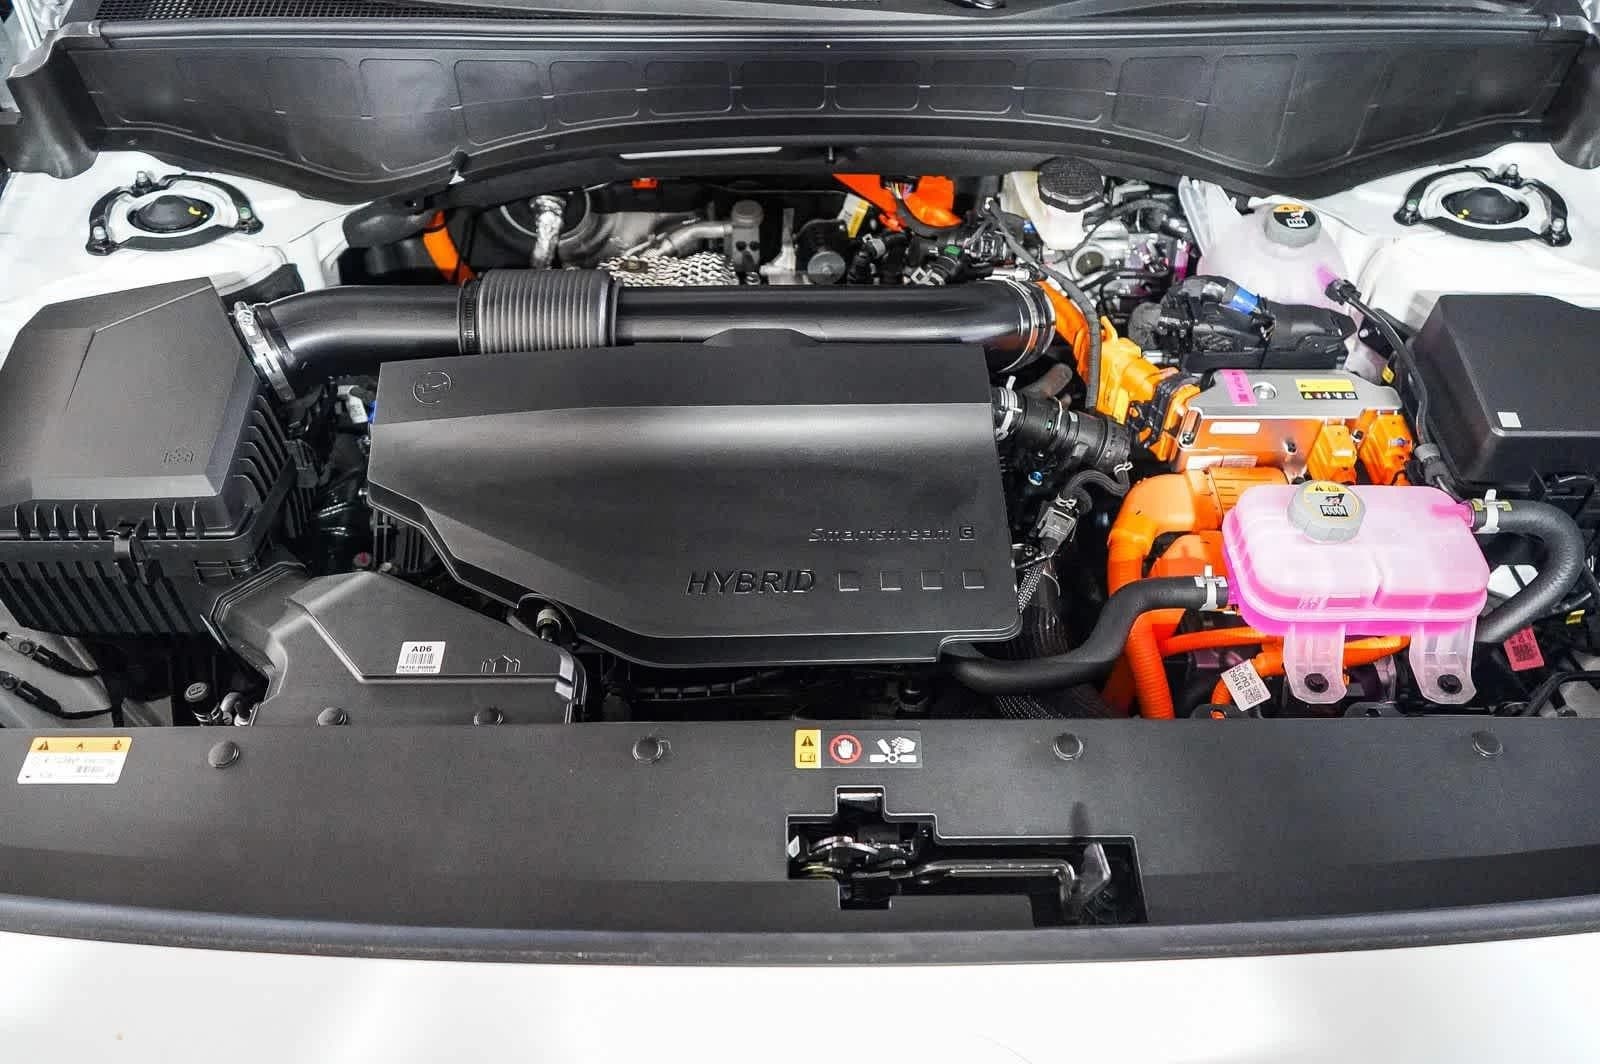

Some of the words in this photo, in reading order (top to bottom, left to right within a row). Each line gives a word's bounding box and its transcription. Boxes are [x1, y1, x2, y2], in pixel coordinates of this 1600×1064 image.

[808, 528, 951, 542] Smartstream
[686, 569, 816, 595] HYBRID
[411, 645, 432, 653] AD6
